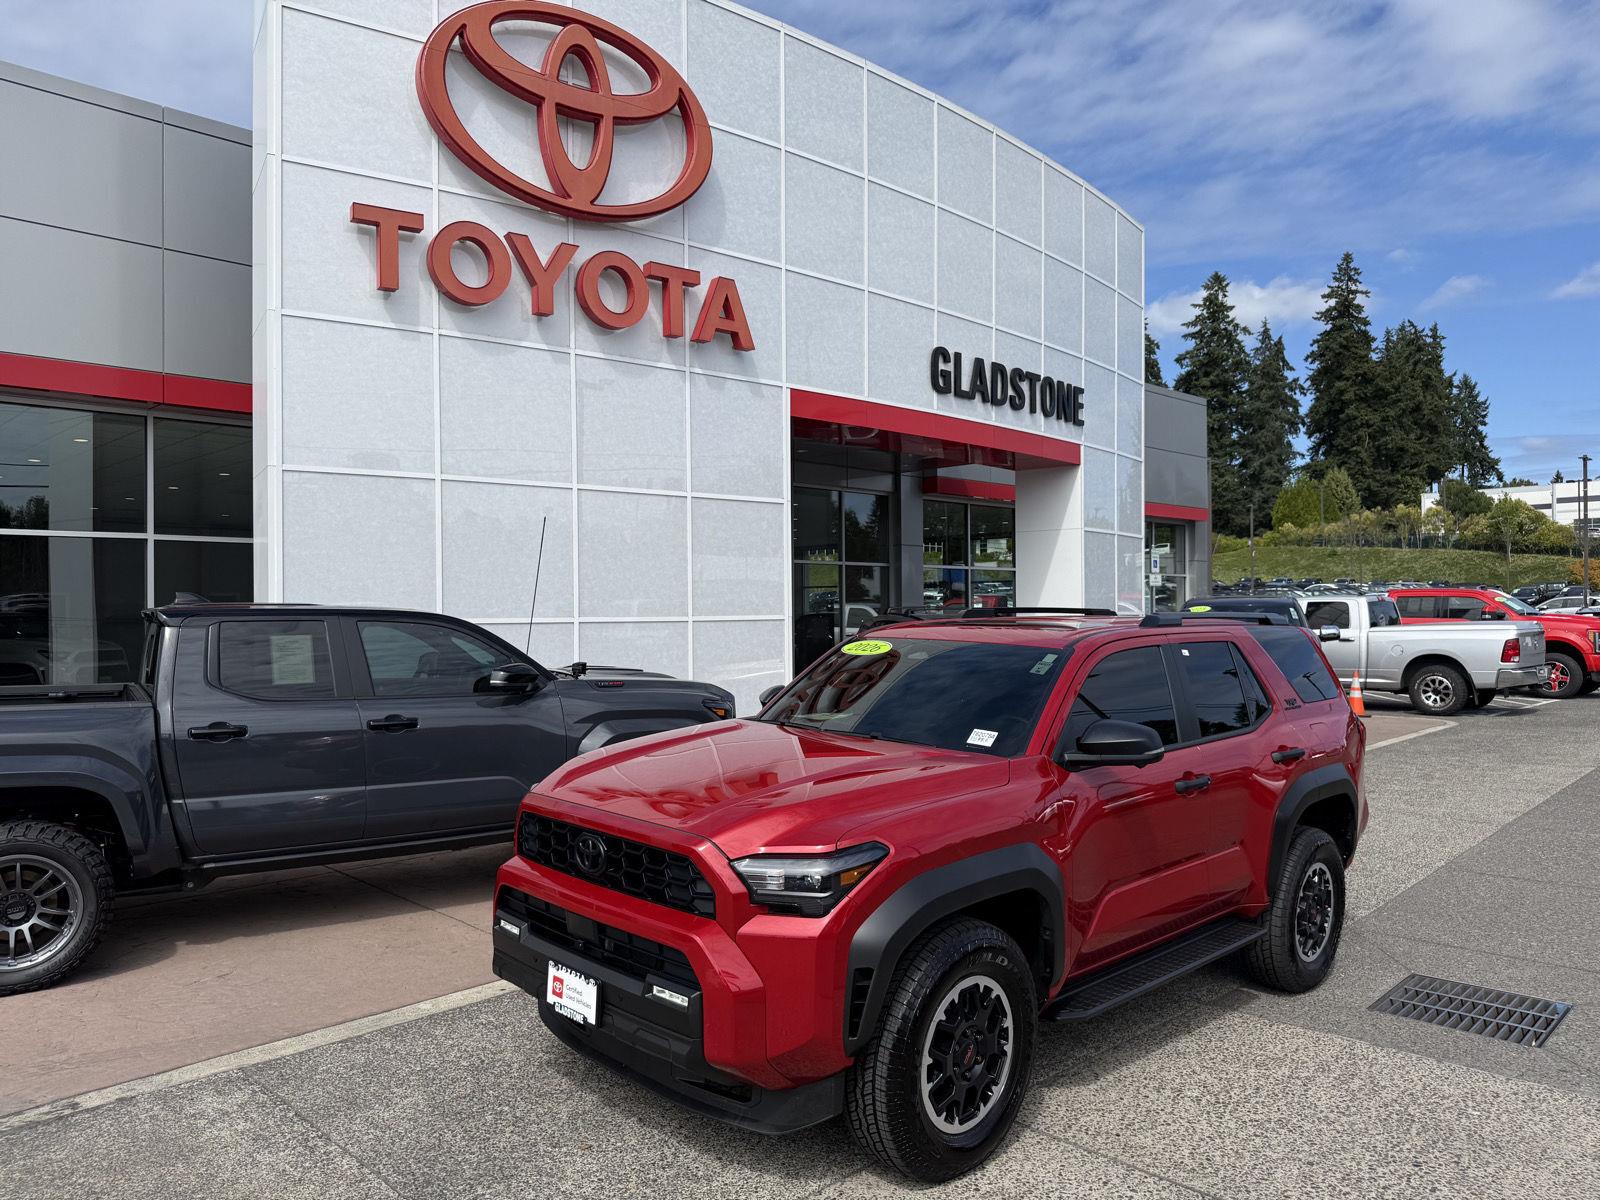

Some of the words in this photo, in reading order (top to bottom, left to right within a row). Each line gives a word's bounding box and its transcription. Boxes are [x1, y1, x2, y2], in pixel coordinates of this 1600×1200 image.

[350, 202, 755, 351] TOYOTA
[930, 346, 1085, 426] GLADSTONE
[558, 964, 585, 981] TOYOTA
[555, 1002, 584, 1024] GLADSTONE
